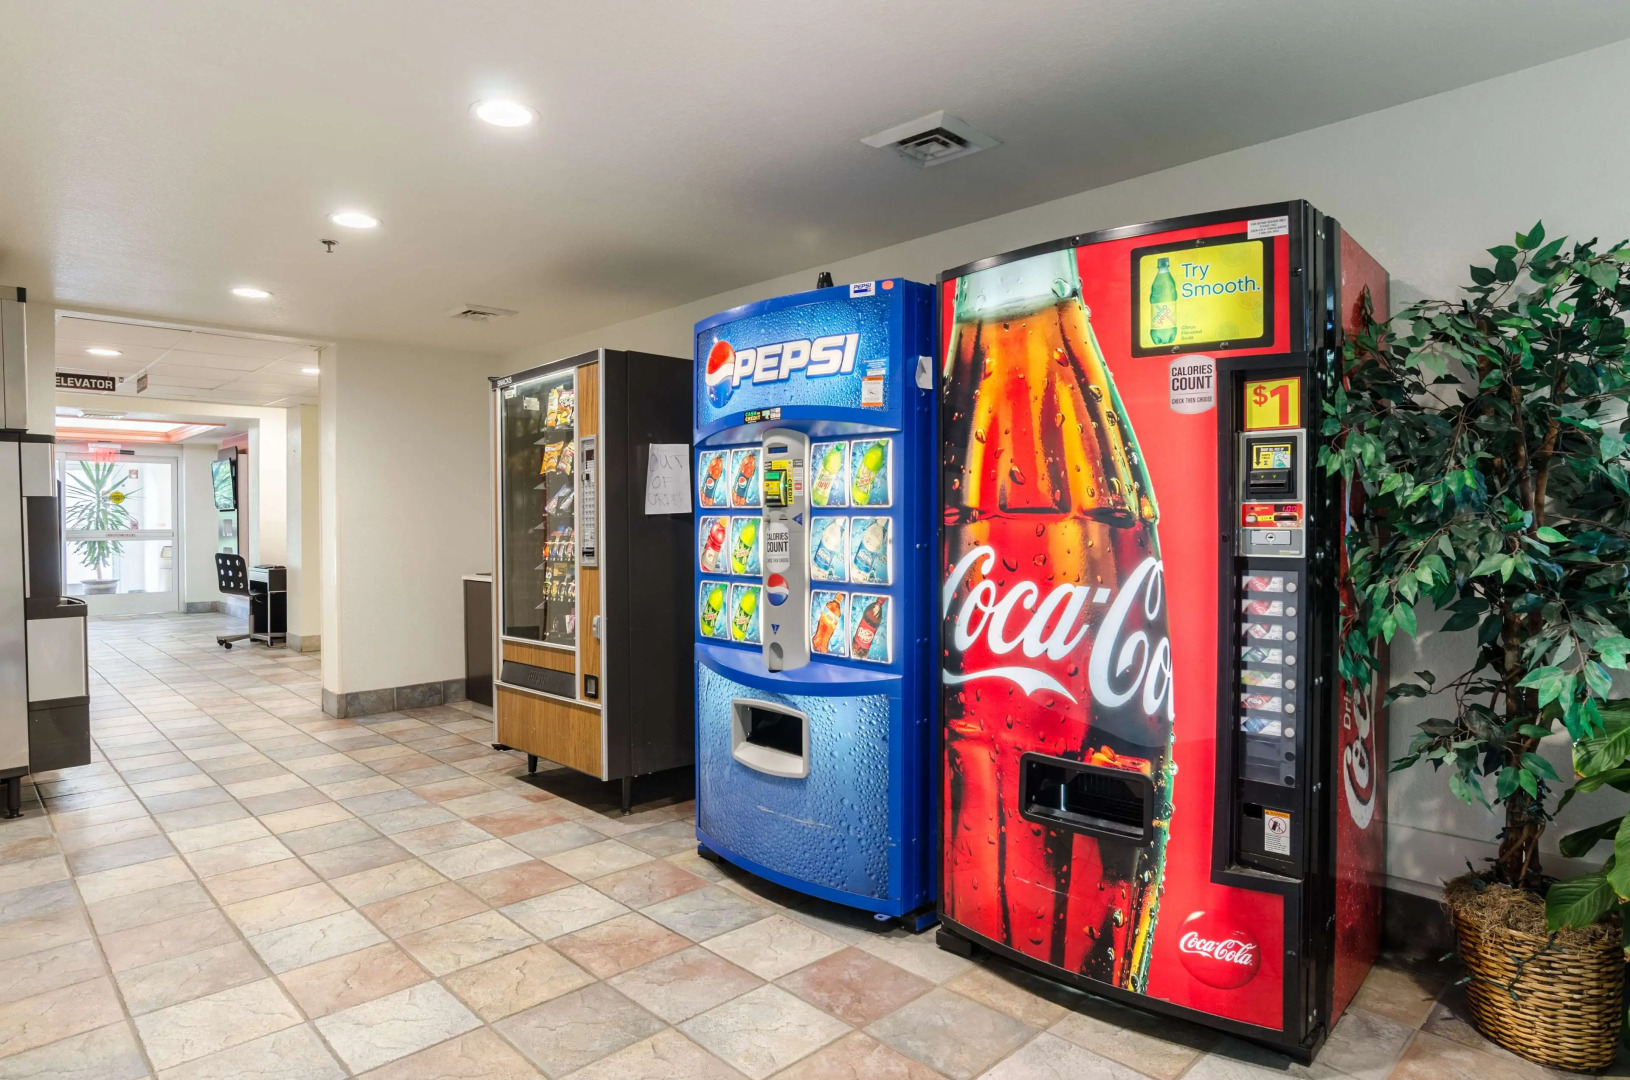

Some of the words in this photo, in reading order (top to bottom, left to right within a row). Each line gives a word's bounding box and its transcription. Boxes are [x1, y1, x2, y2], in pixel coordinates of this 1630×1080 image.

[1181, 262, 1210, 281] Try
[1181, 275, 1261, 299] Smooth.
[1152, 304, 1168, 323] mello
[732, 333, 860, 387] PEPSI
[1171, 363, 1213, 377] CALORIES
[55, 376, 113, 390] ELEVATOR
[496, 376, 513, 387] SNACKS
[1171, 376, 1213, 392] COUNT
[1196, 395, 1213, 403] CHOOSE
[1252, 384, 1290, 426] $1
[650, 453, 688, 472] OUT
[651, 475, 673, 489] OF
[767, 541, 789, 553] COUNT
[1179, 931, 1258, 966] Coca-Cola
